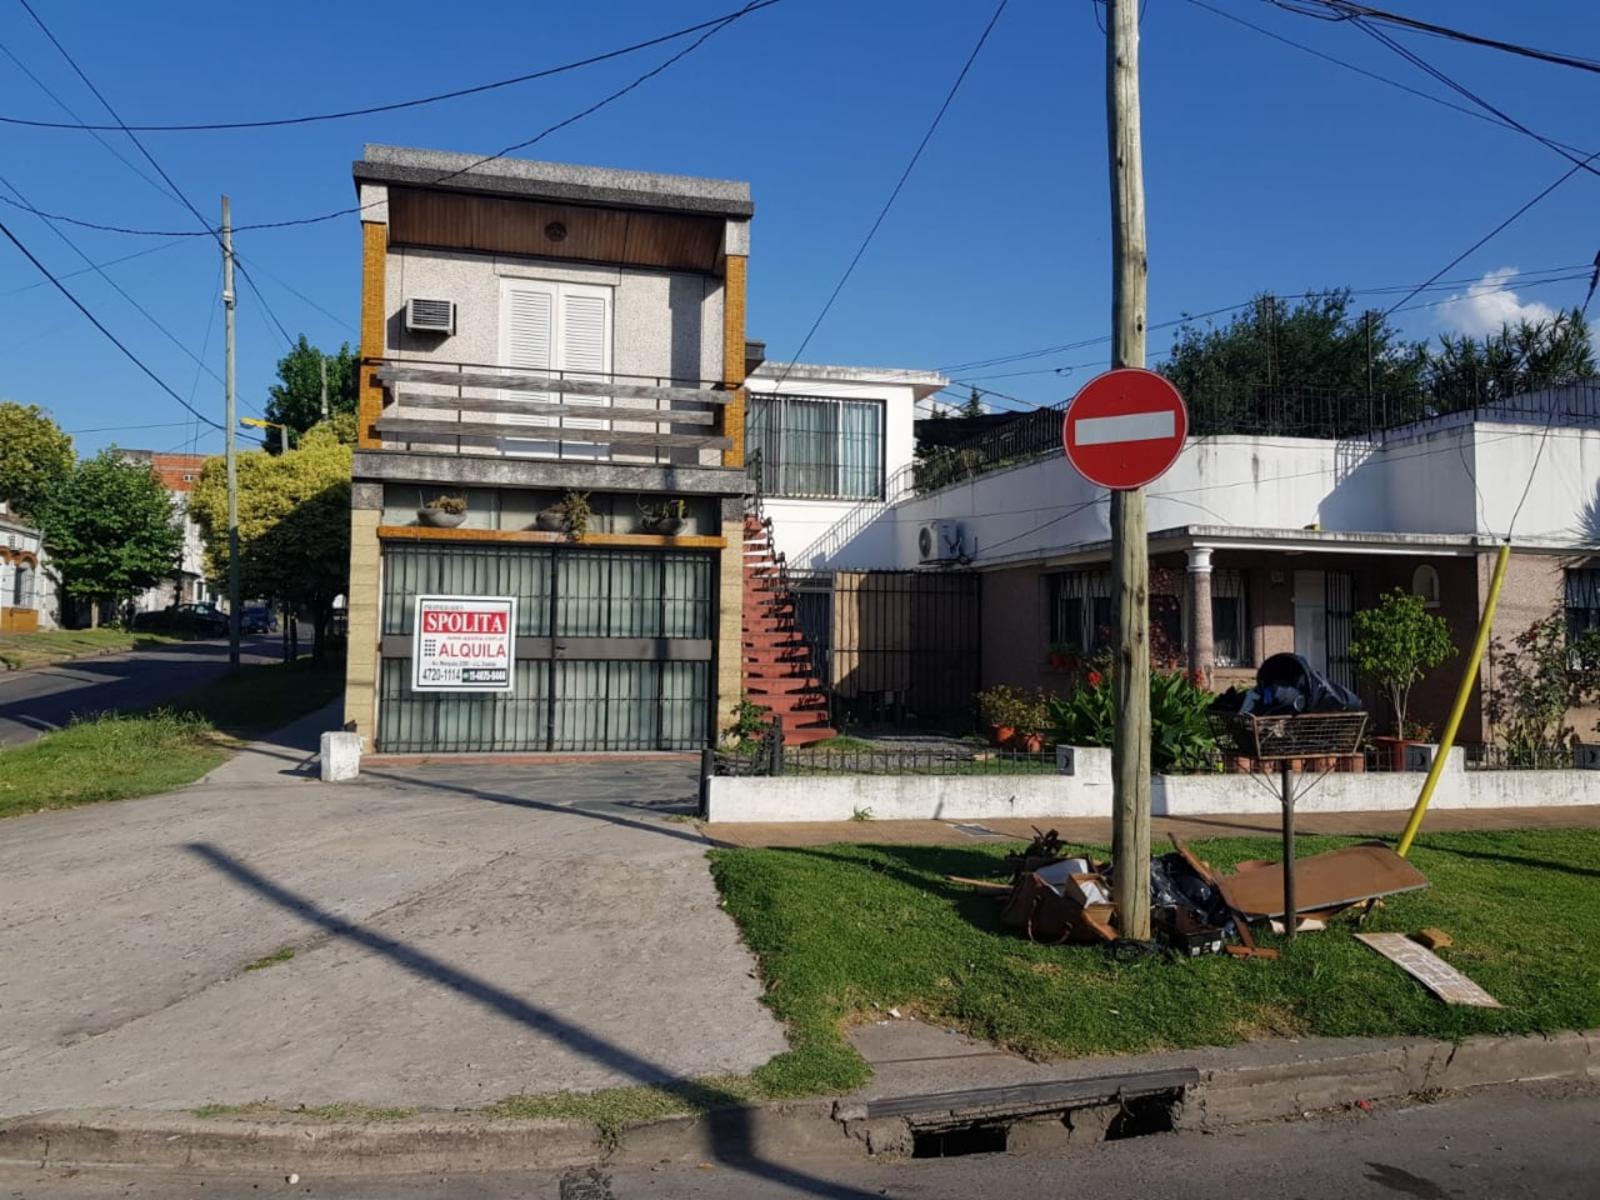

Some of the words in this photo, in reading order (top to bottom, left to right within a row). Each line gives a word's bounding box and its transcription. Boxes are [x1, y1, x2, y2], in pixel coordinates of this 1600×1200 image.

[426, 613, 503, 632] SPOLITA
[439, 643, 506, 657] ALQUILA
[423, 668, 460, 681] 4720-1114
